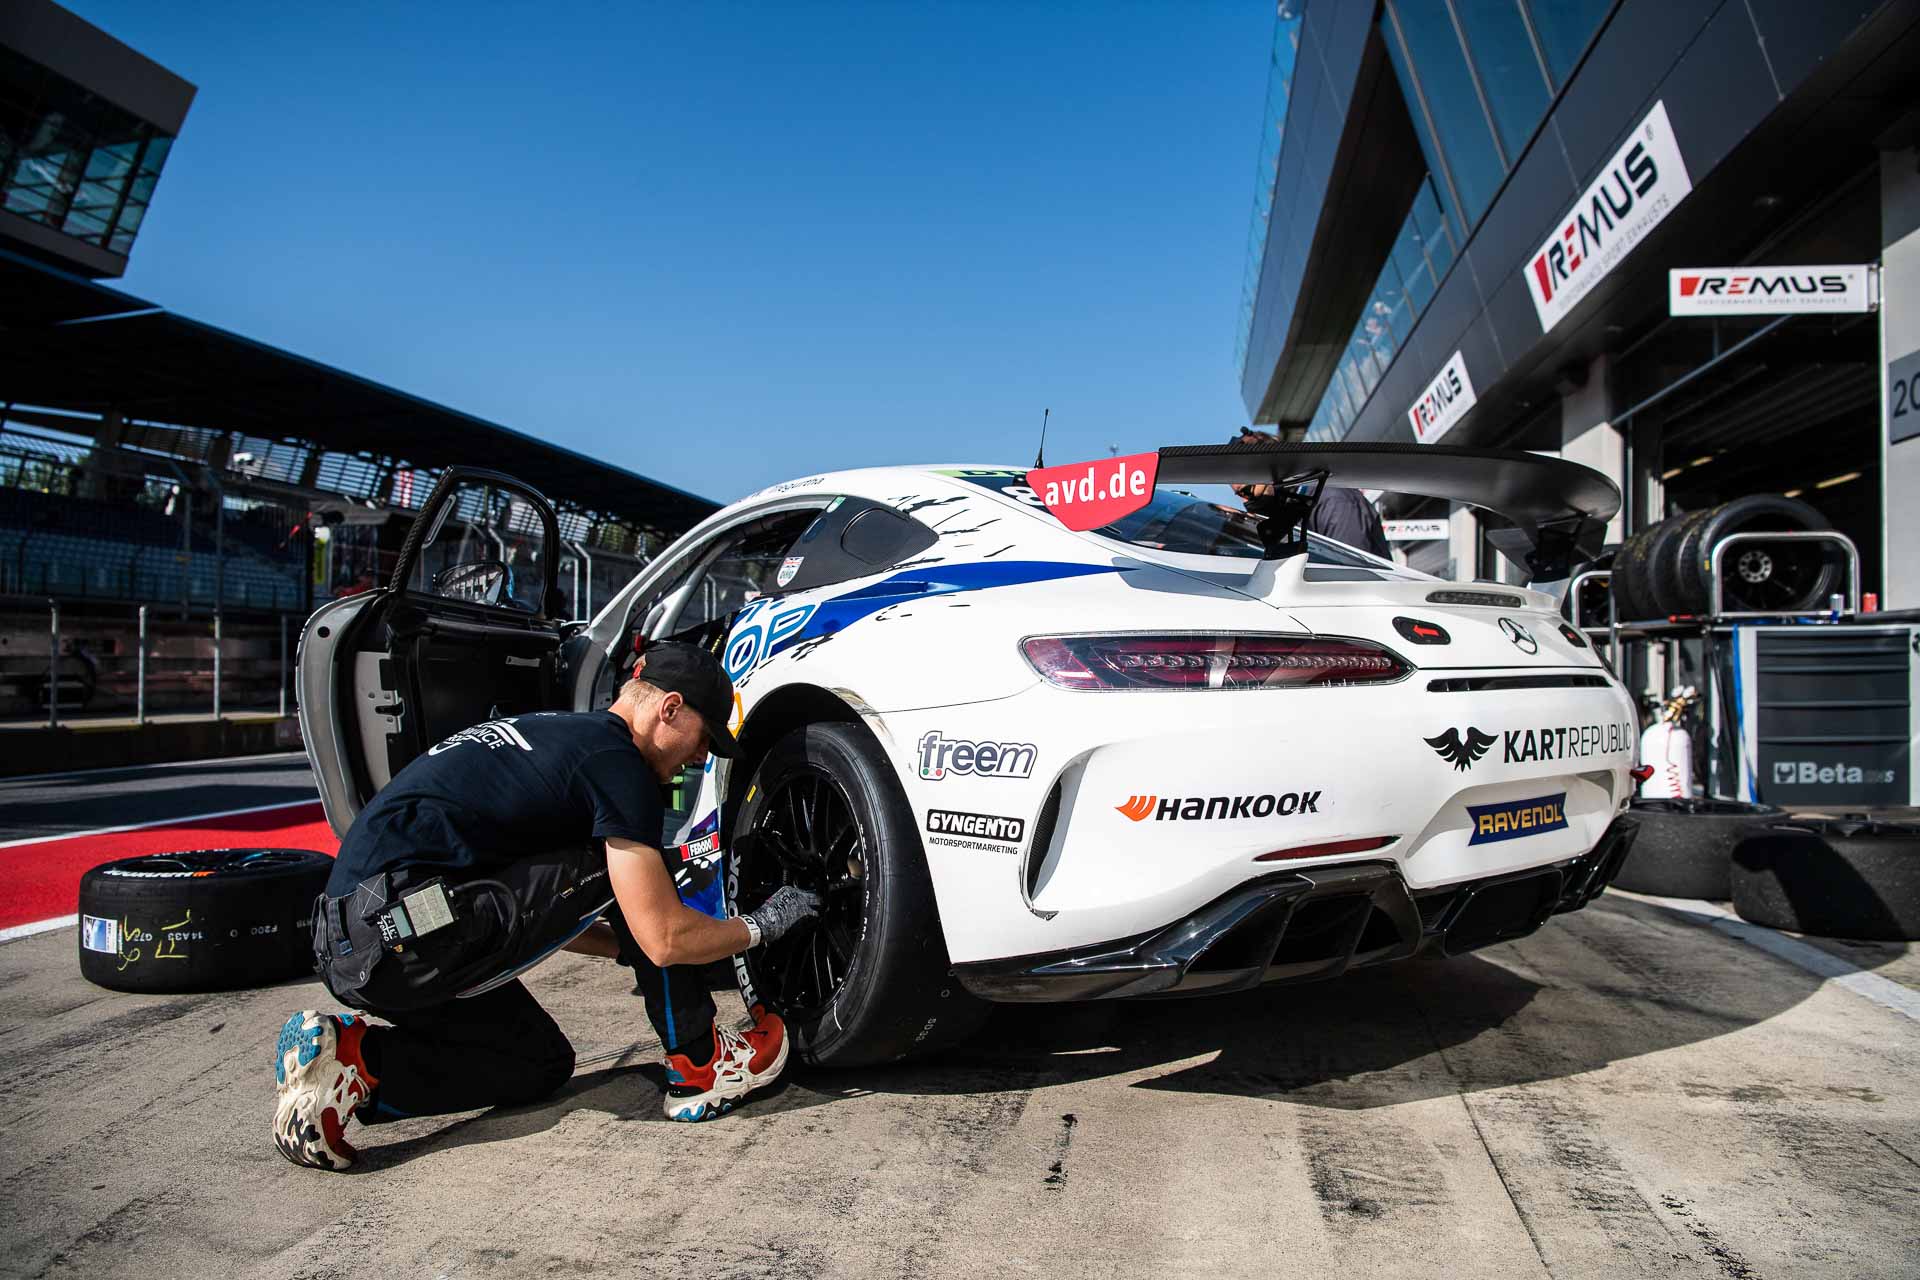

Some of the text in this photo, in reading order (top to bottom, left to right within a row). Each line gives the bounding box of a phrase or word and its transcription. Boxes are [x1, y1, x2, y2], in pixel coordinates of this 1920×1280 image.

[1549, 141, 1659, 291] REMUS
[1699, 276, 1847, 295] REMUS
[1420, 368, 1462, 427] REMUS
[1045, 462, 1146, 507] avd.de
[922, 735, 1034, 774] freem
[1798, 762, 1863, 784] Beta
[929, 812, 1021, 839] SYNGENTO
[1479, 804, 1563, 836] RAVENOL
[929, 836, 1019, 855] MOTORSPORTMARKETING
